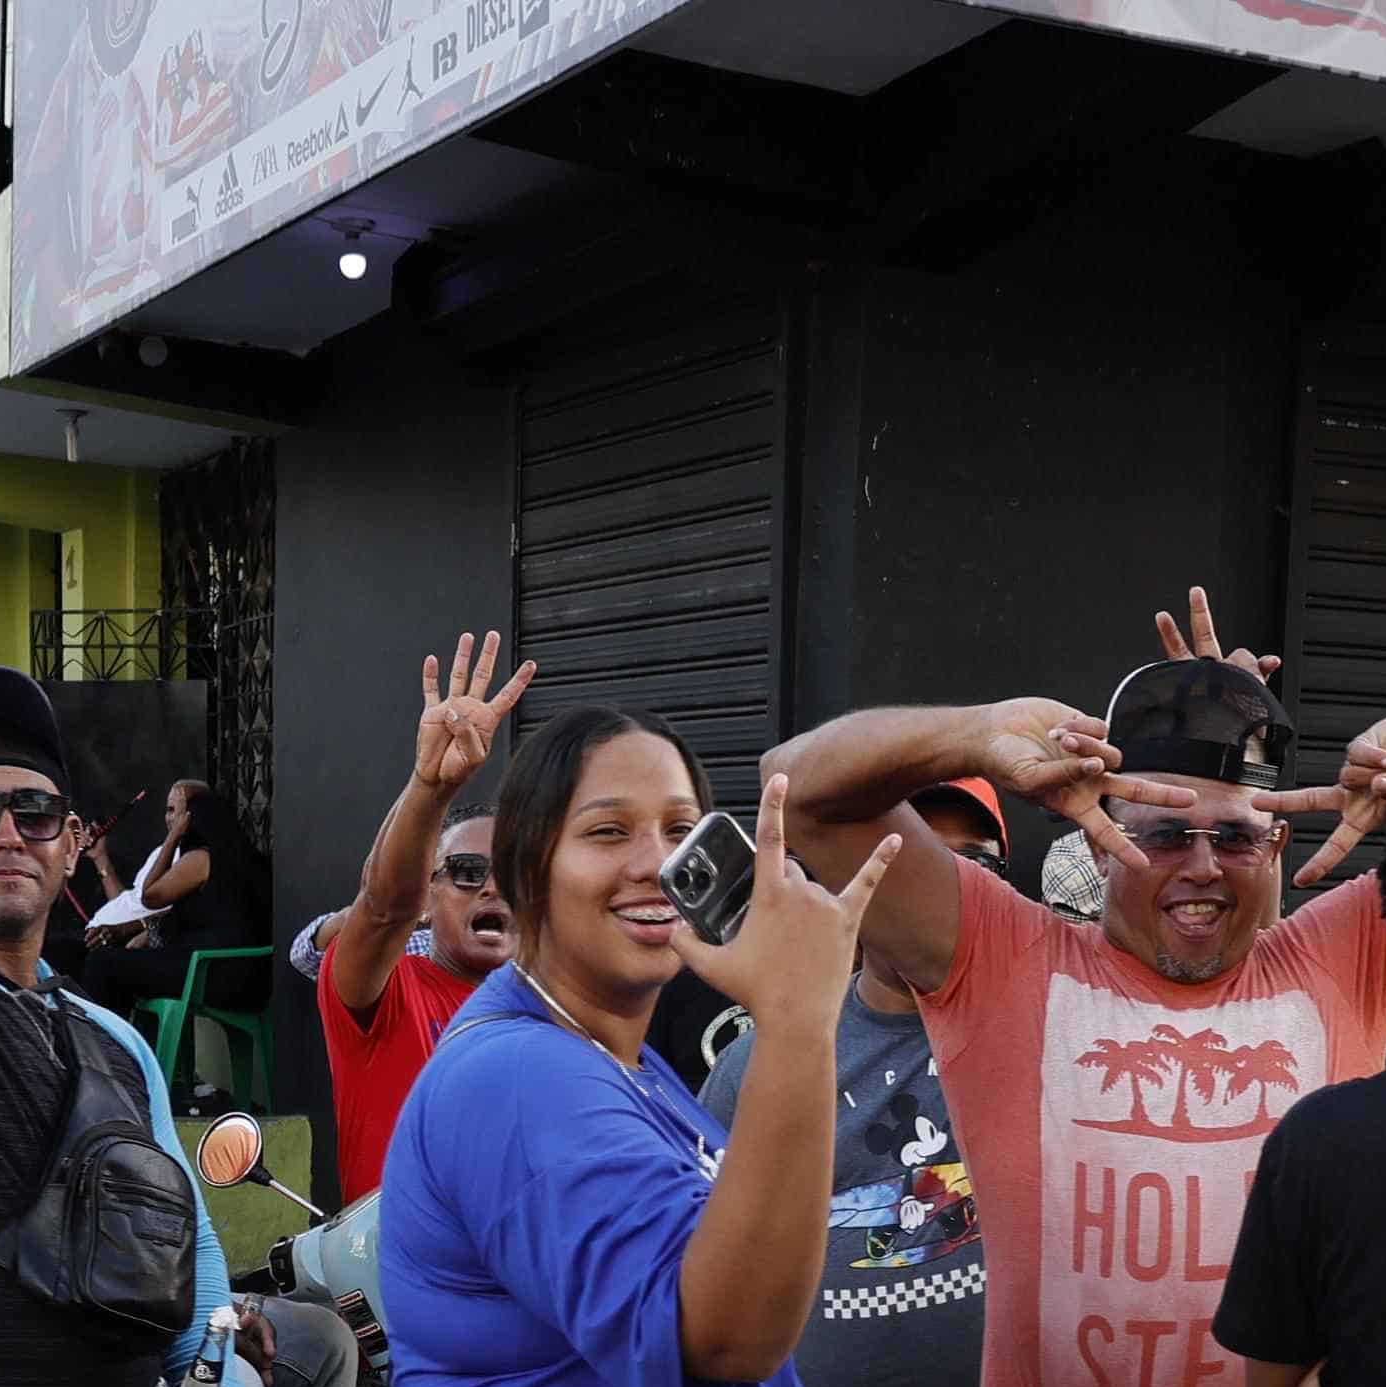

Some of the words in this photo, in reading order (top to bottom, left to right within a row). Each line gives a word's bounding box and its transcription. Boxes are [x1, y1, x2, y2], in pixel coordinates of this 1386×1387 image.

[214, 188, 244, 218] adidas
[286, 120, 333, 172] Reebok
[466, 0, 515, 54] DIESEL
[1072, 1160, 1258, 1282] HOL
